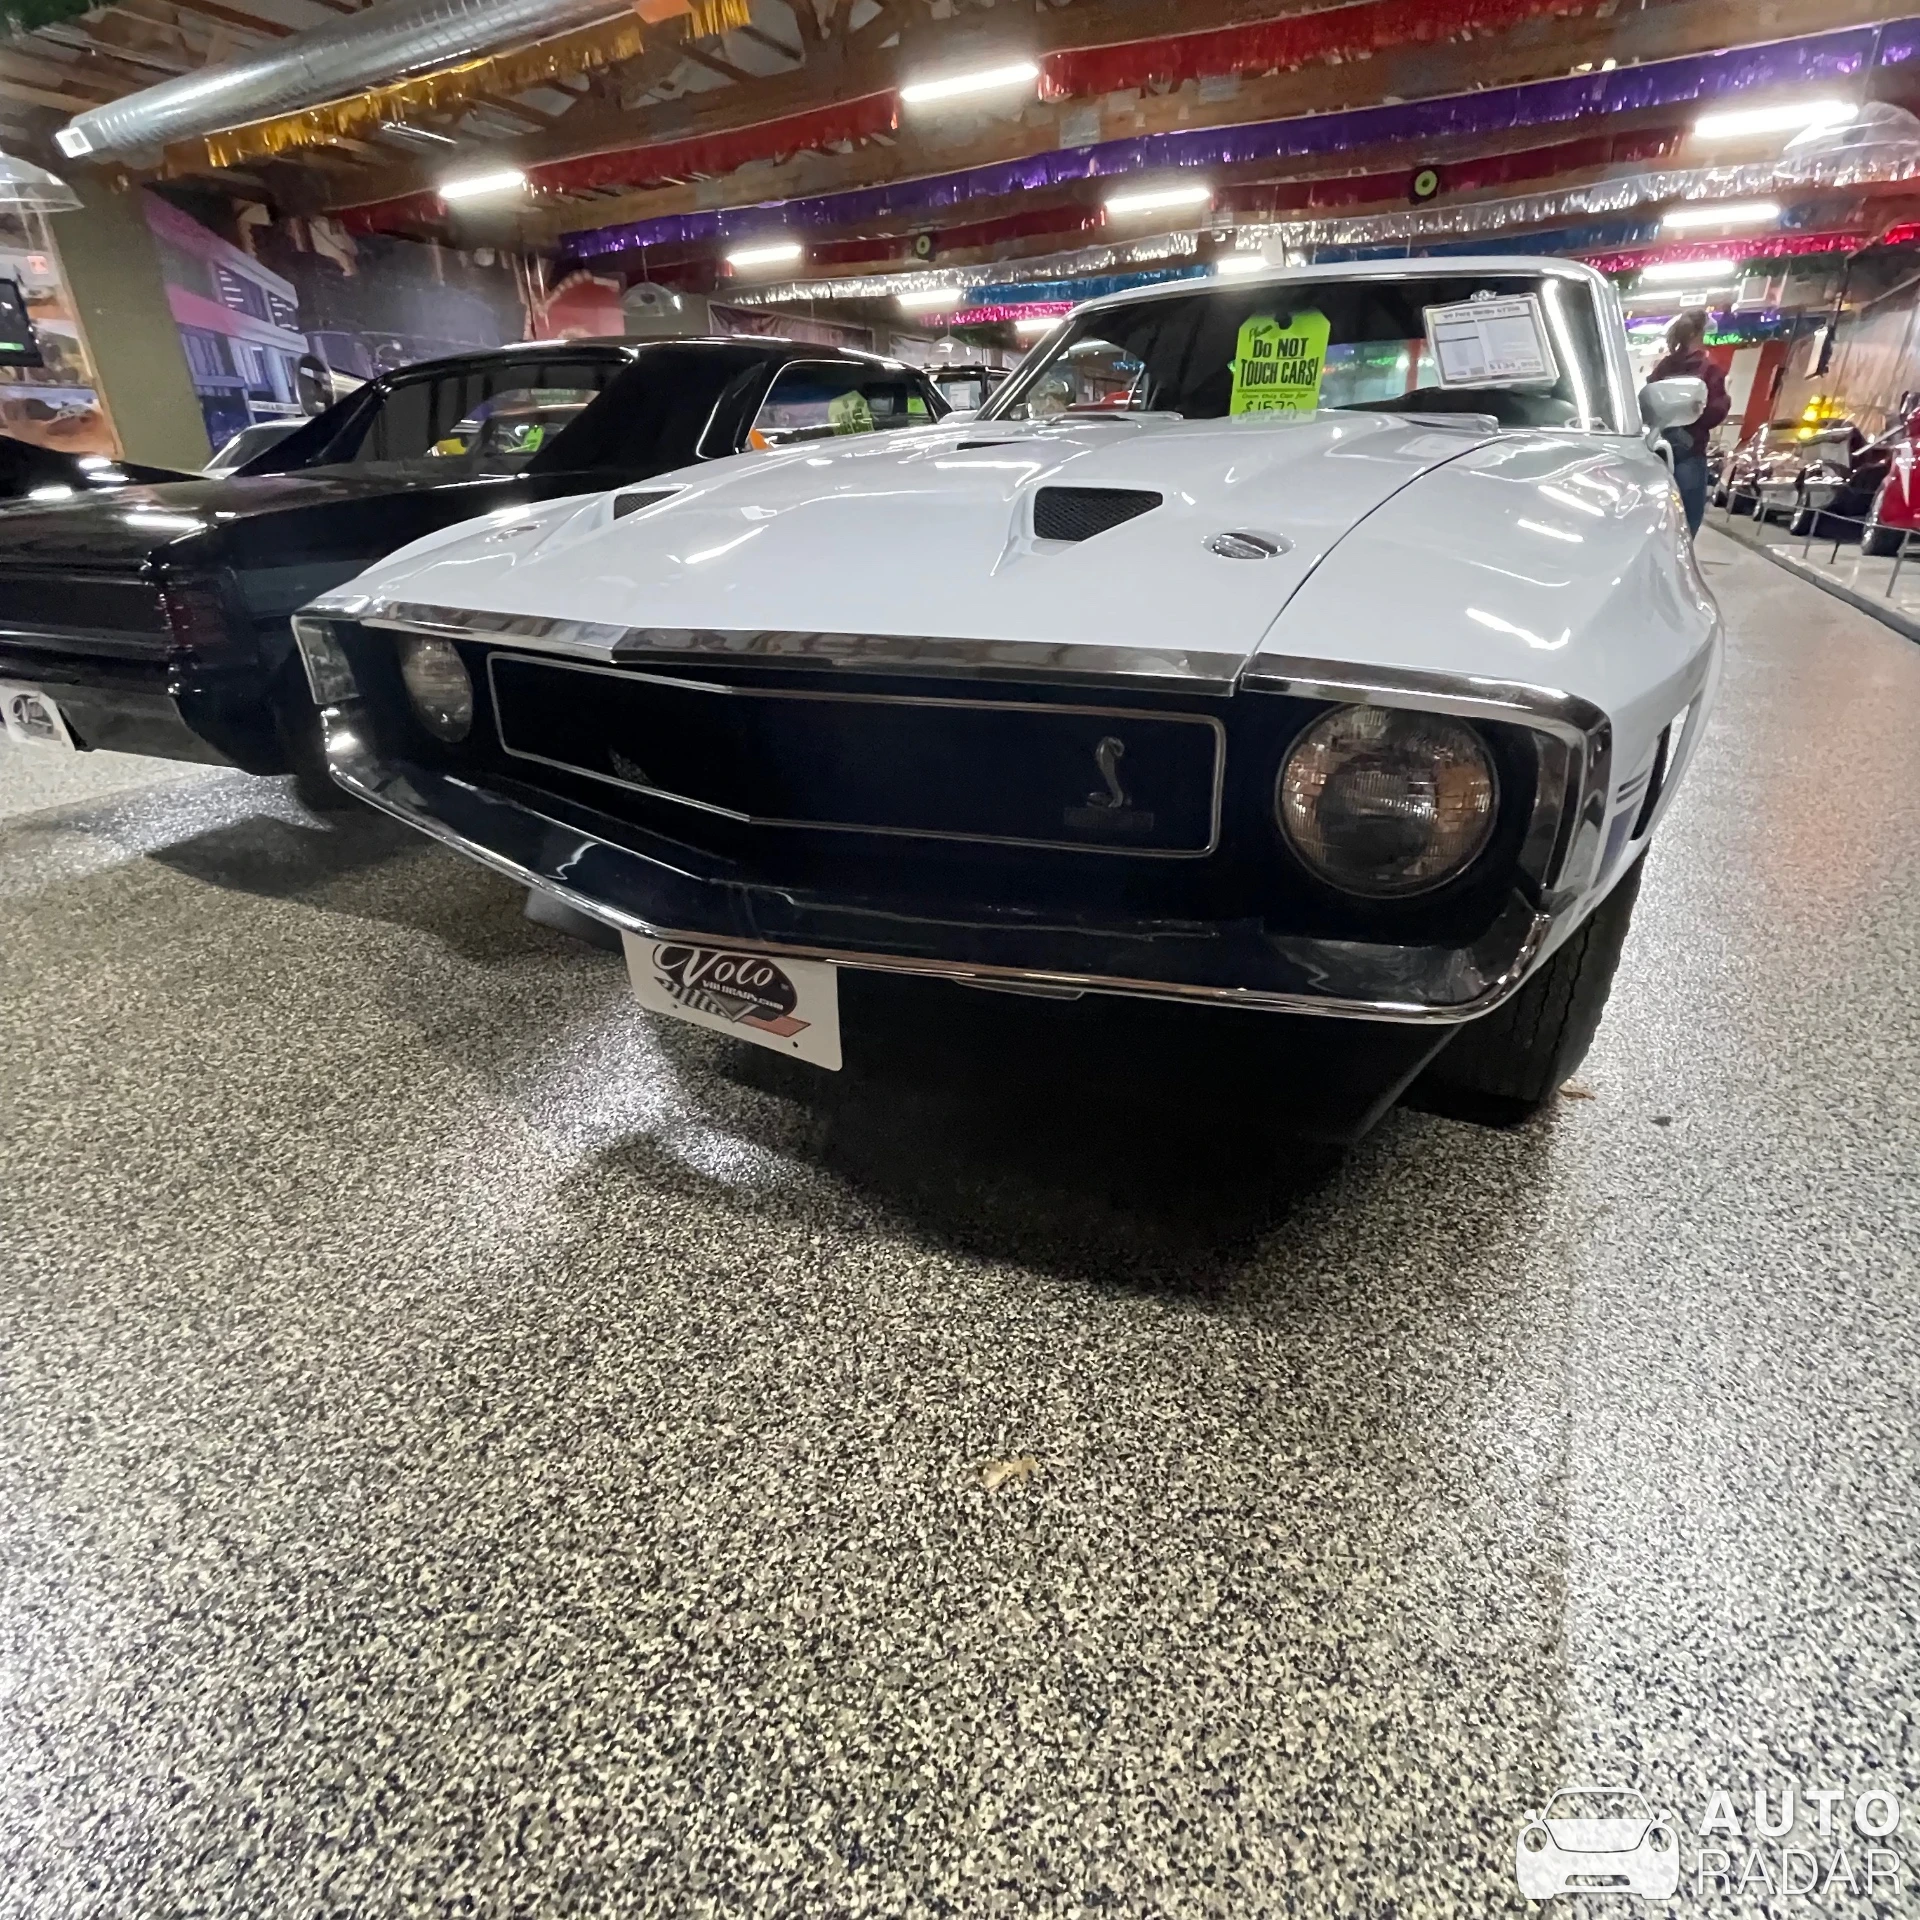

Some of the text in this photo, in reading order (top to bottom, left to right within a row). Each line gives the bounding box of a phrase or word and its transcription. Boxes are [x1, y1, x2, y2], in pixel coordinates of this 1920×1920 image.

[1277, 337, 1309, 357] NOT
[1240, 357, 1319, 387] TOUCH CARS!
[653, 944, 774, 988] Volo
